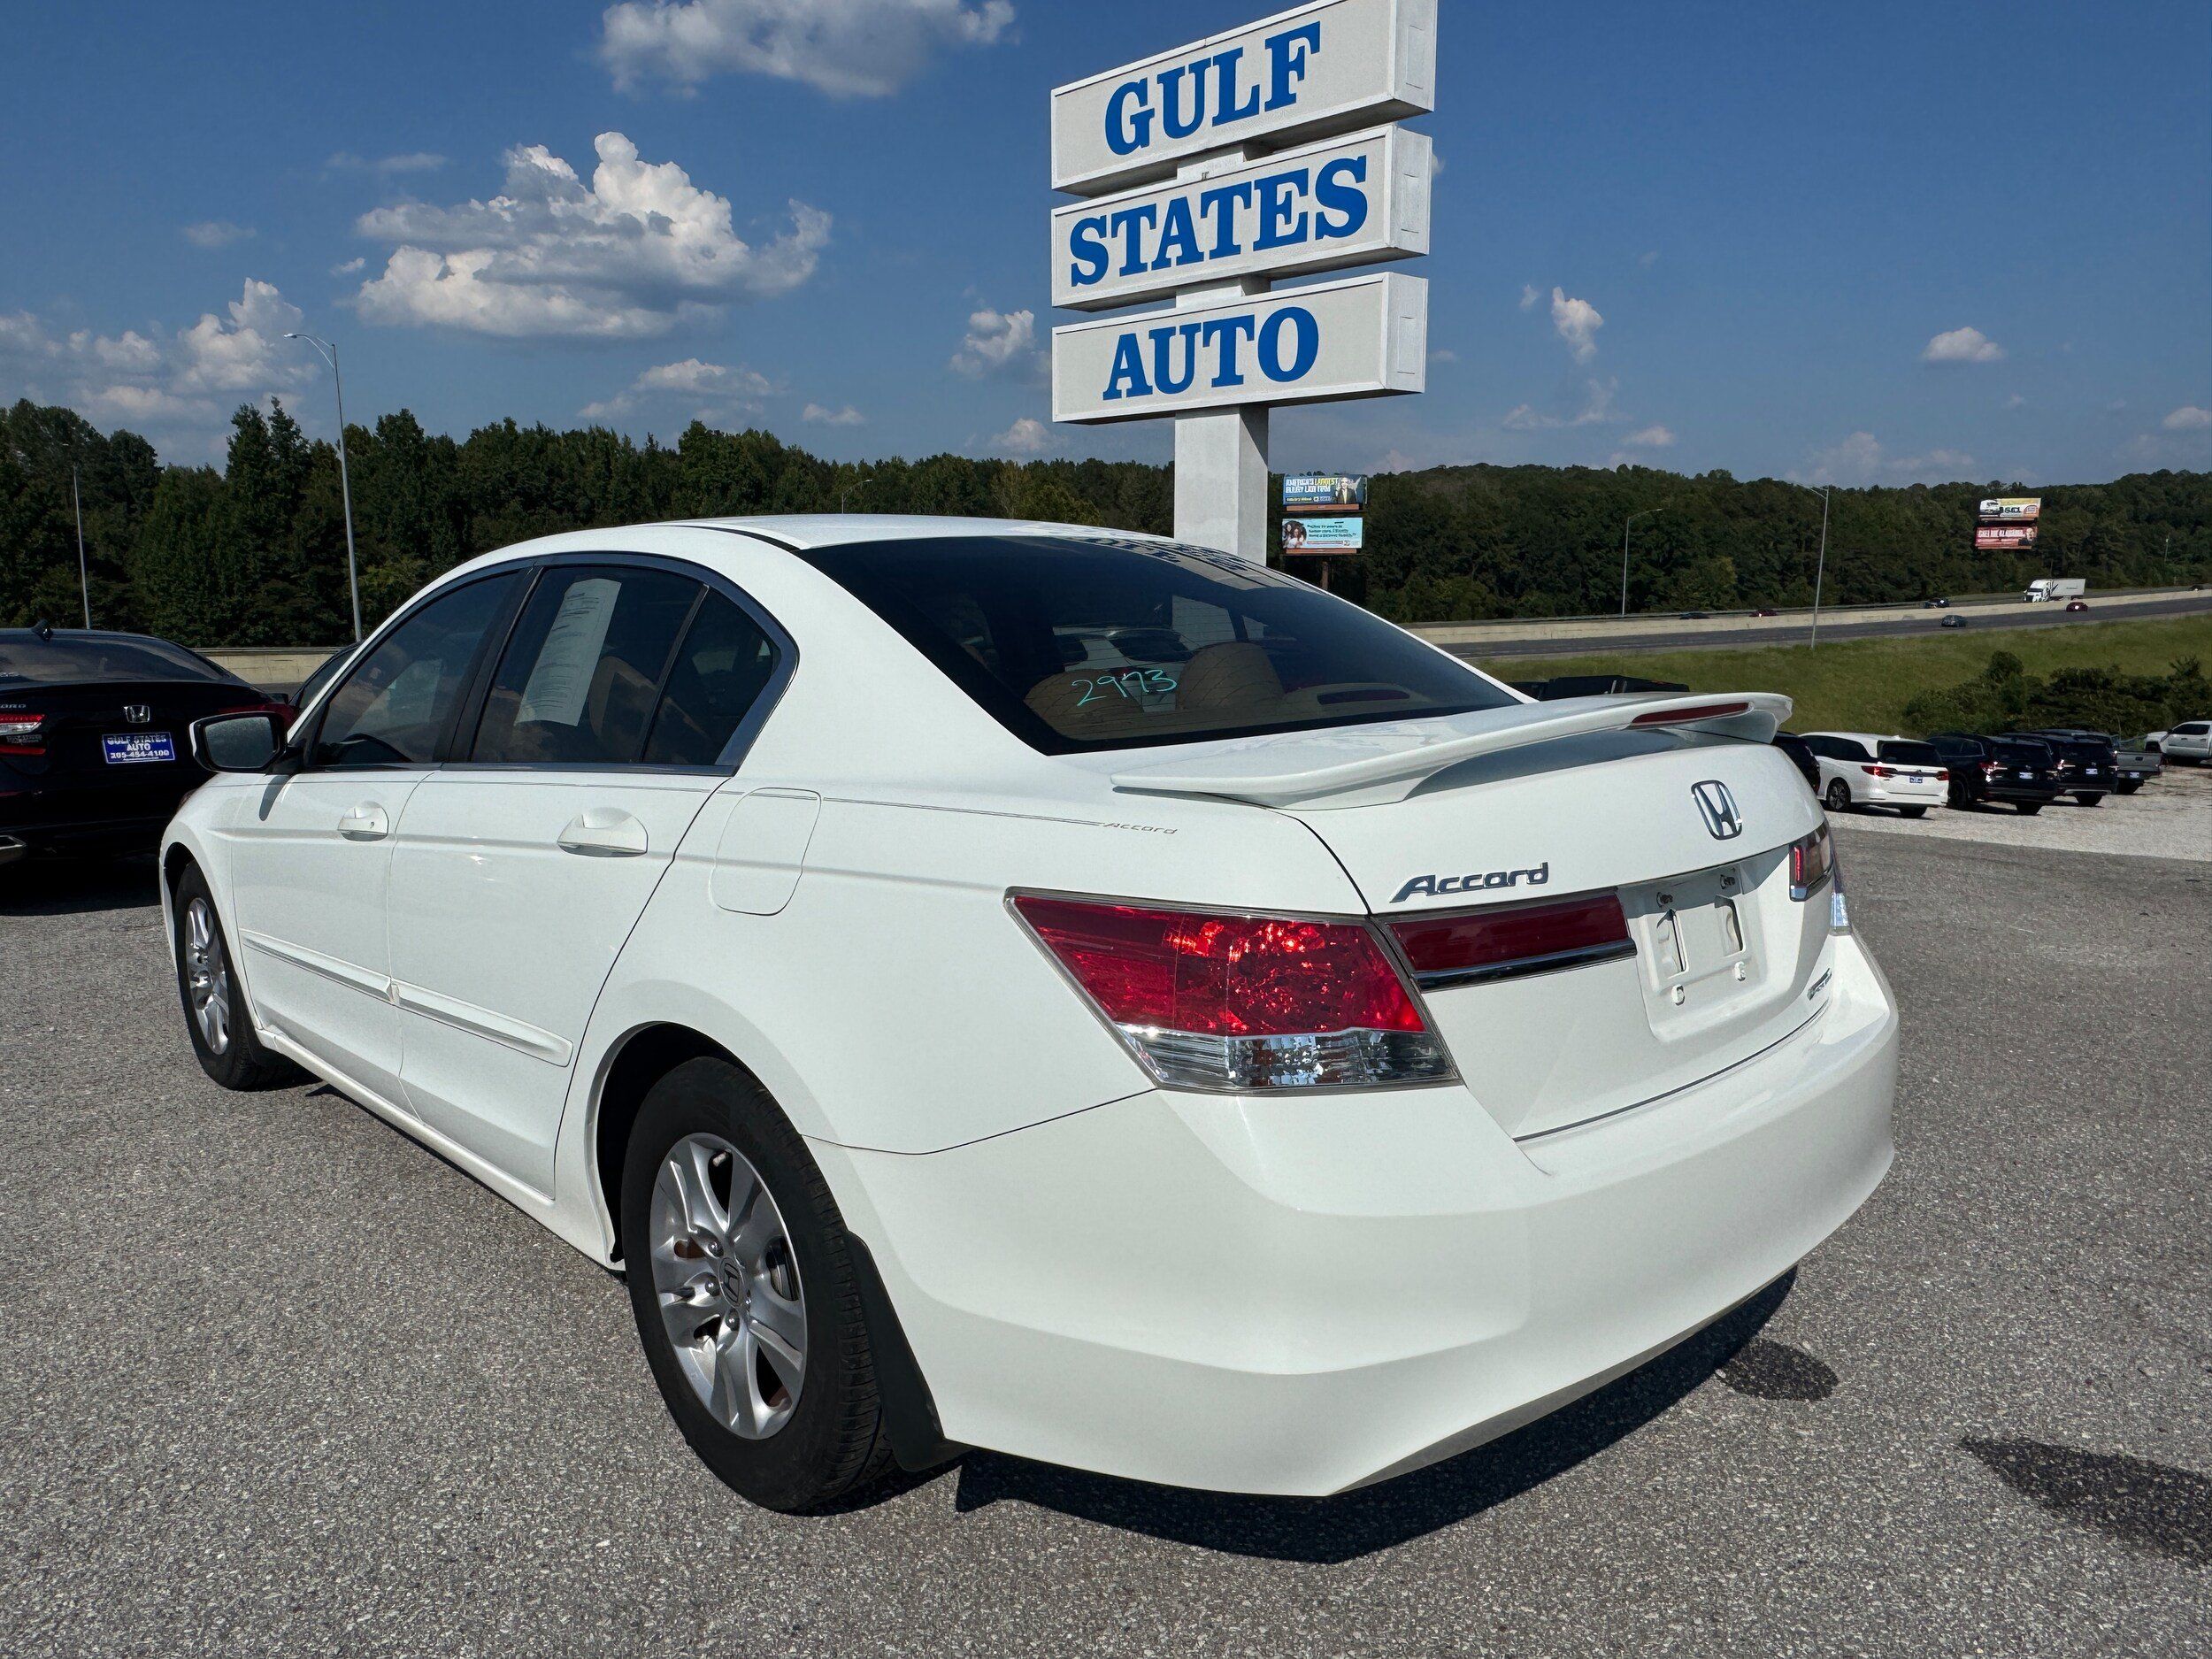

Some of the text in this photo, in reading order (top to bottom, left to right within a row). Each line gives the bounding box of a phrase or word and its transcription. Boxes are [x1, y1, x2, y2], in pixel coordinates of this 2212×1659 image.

[1104, 21, 1321, 156] GULF
[1070, 155, 1368, 288] STATES
[1102, 306, 1319, 401] AUTO
[1103, 822, 1178, 834] Accord
[1389, 862, 1548, 903] Accord
